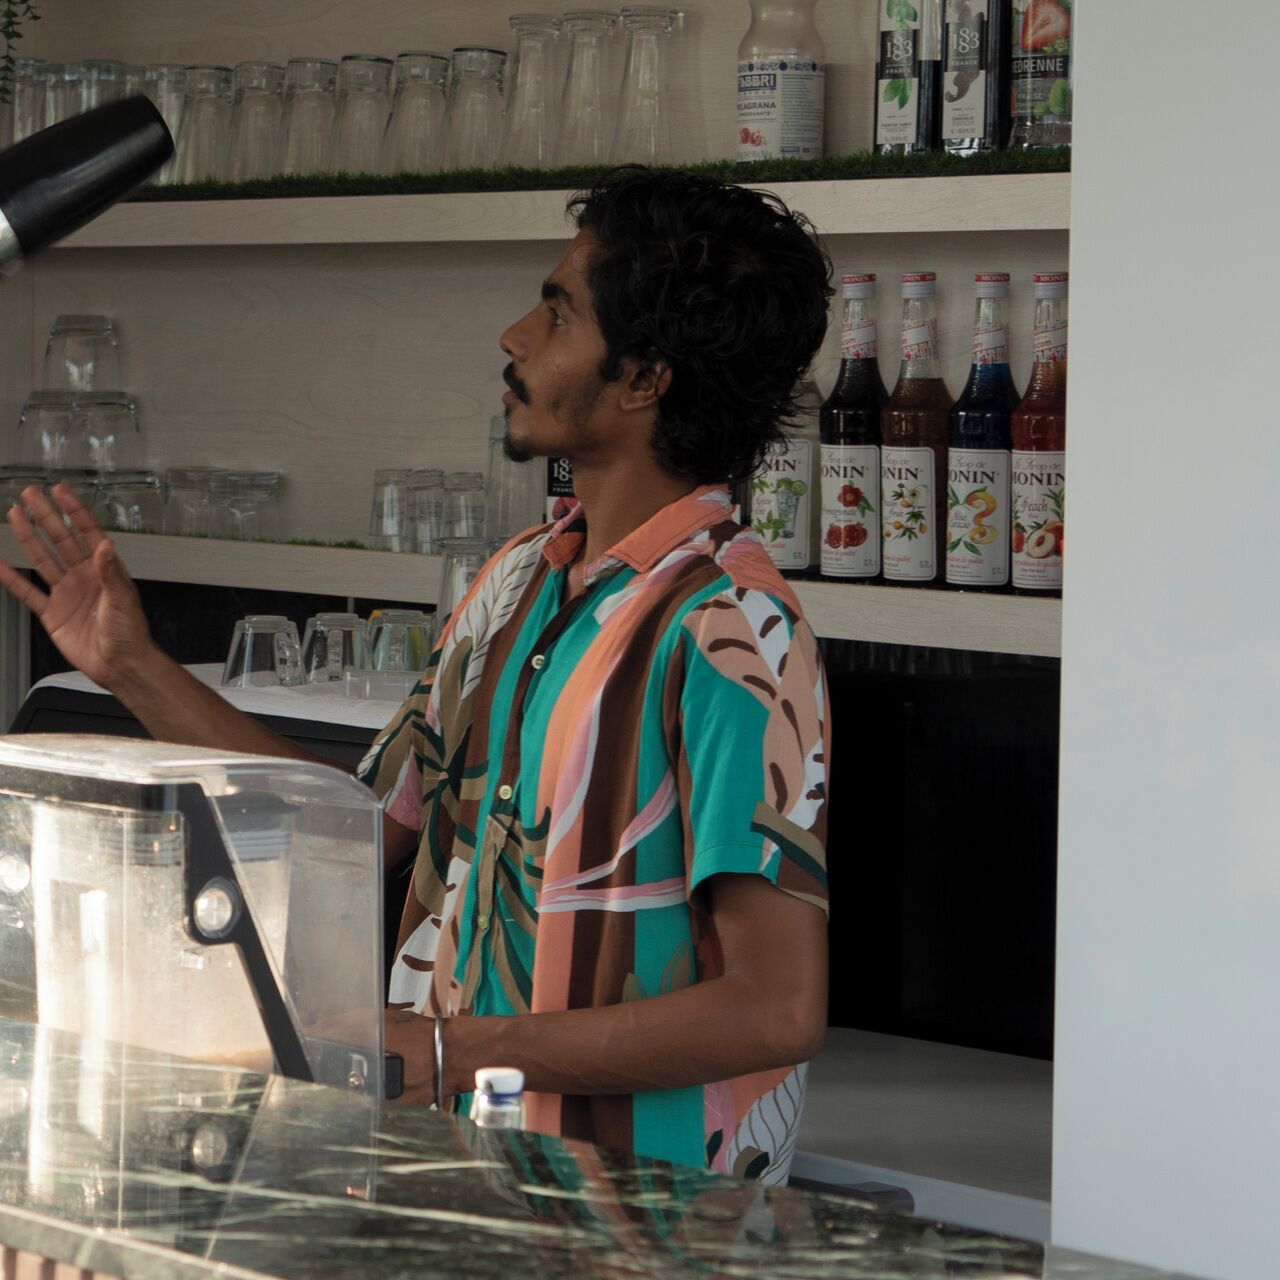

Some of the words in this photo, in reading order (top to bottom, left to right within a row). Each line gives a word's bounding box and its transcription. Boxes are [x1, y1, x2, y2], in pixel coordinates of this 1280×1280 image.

[1011, 58, 1065, 74] EDRENNE
[737, 101, 777, 111] ELAGRANA
[552, 458, 574, 482] 188
[761, 459, 798, 472] NIN
[822, 465, 866, 479] ONIN
[882, 467, 920, 481] NIN
[948, 470, 997, 484] ONIN
